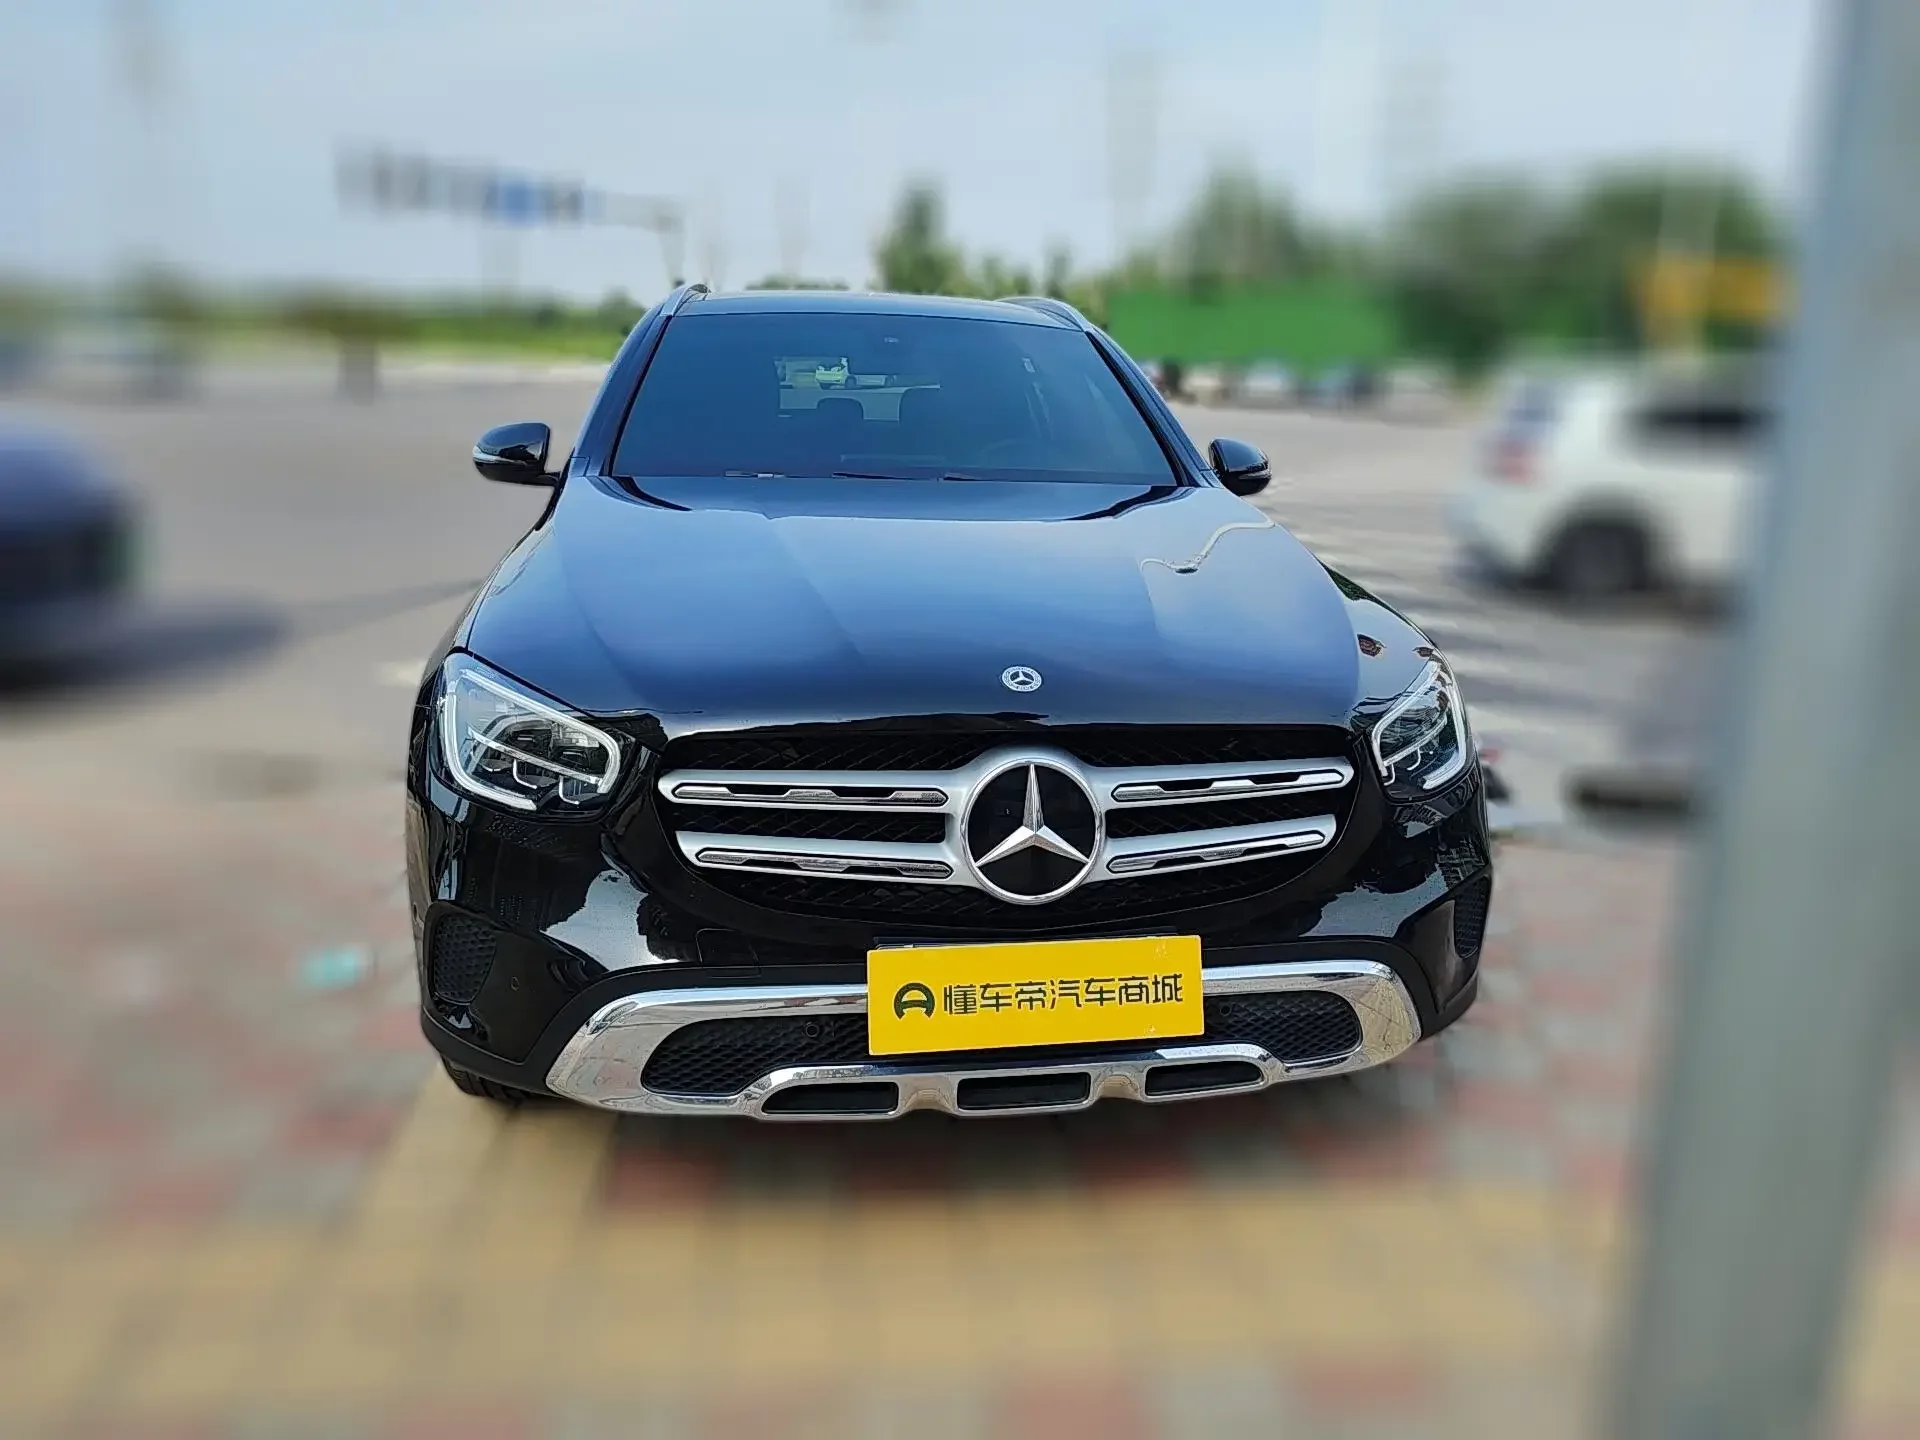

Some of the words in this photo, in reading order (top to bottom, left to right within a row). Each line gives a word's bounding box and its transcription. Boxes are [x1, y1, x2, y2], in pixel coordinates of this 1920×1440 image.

[943, 973, 1183, 1015] 懂车帝汽车商城
